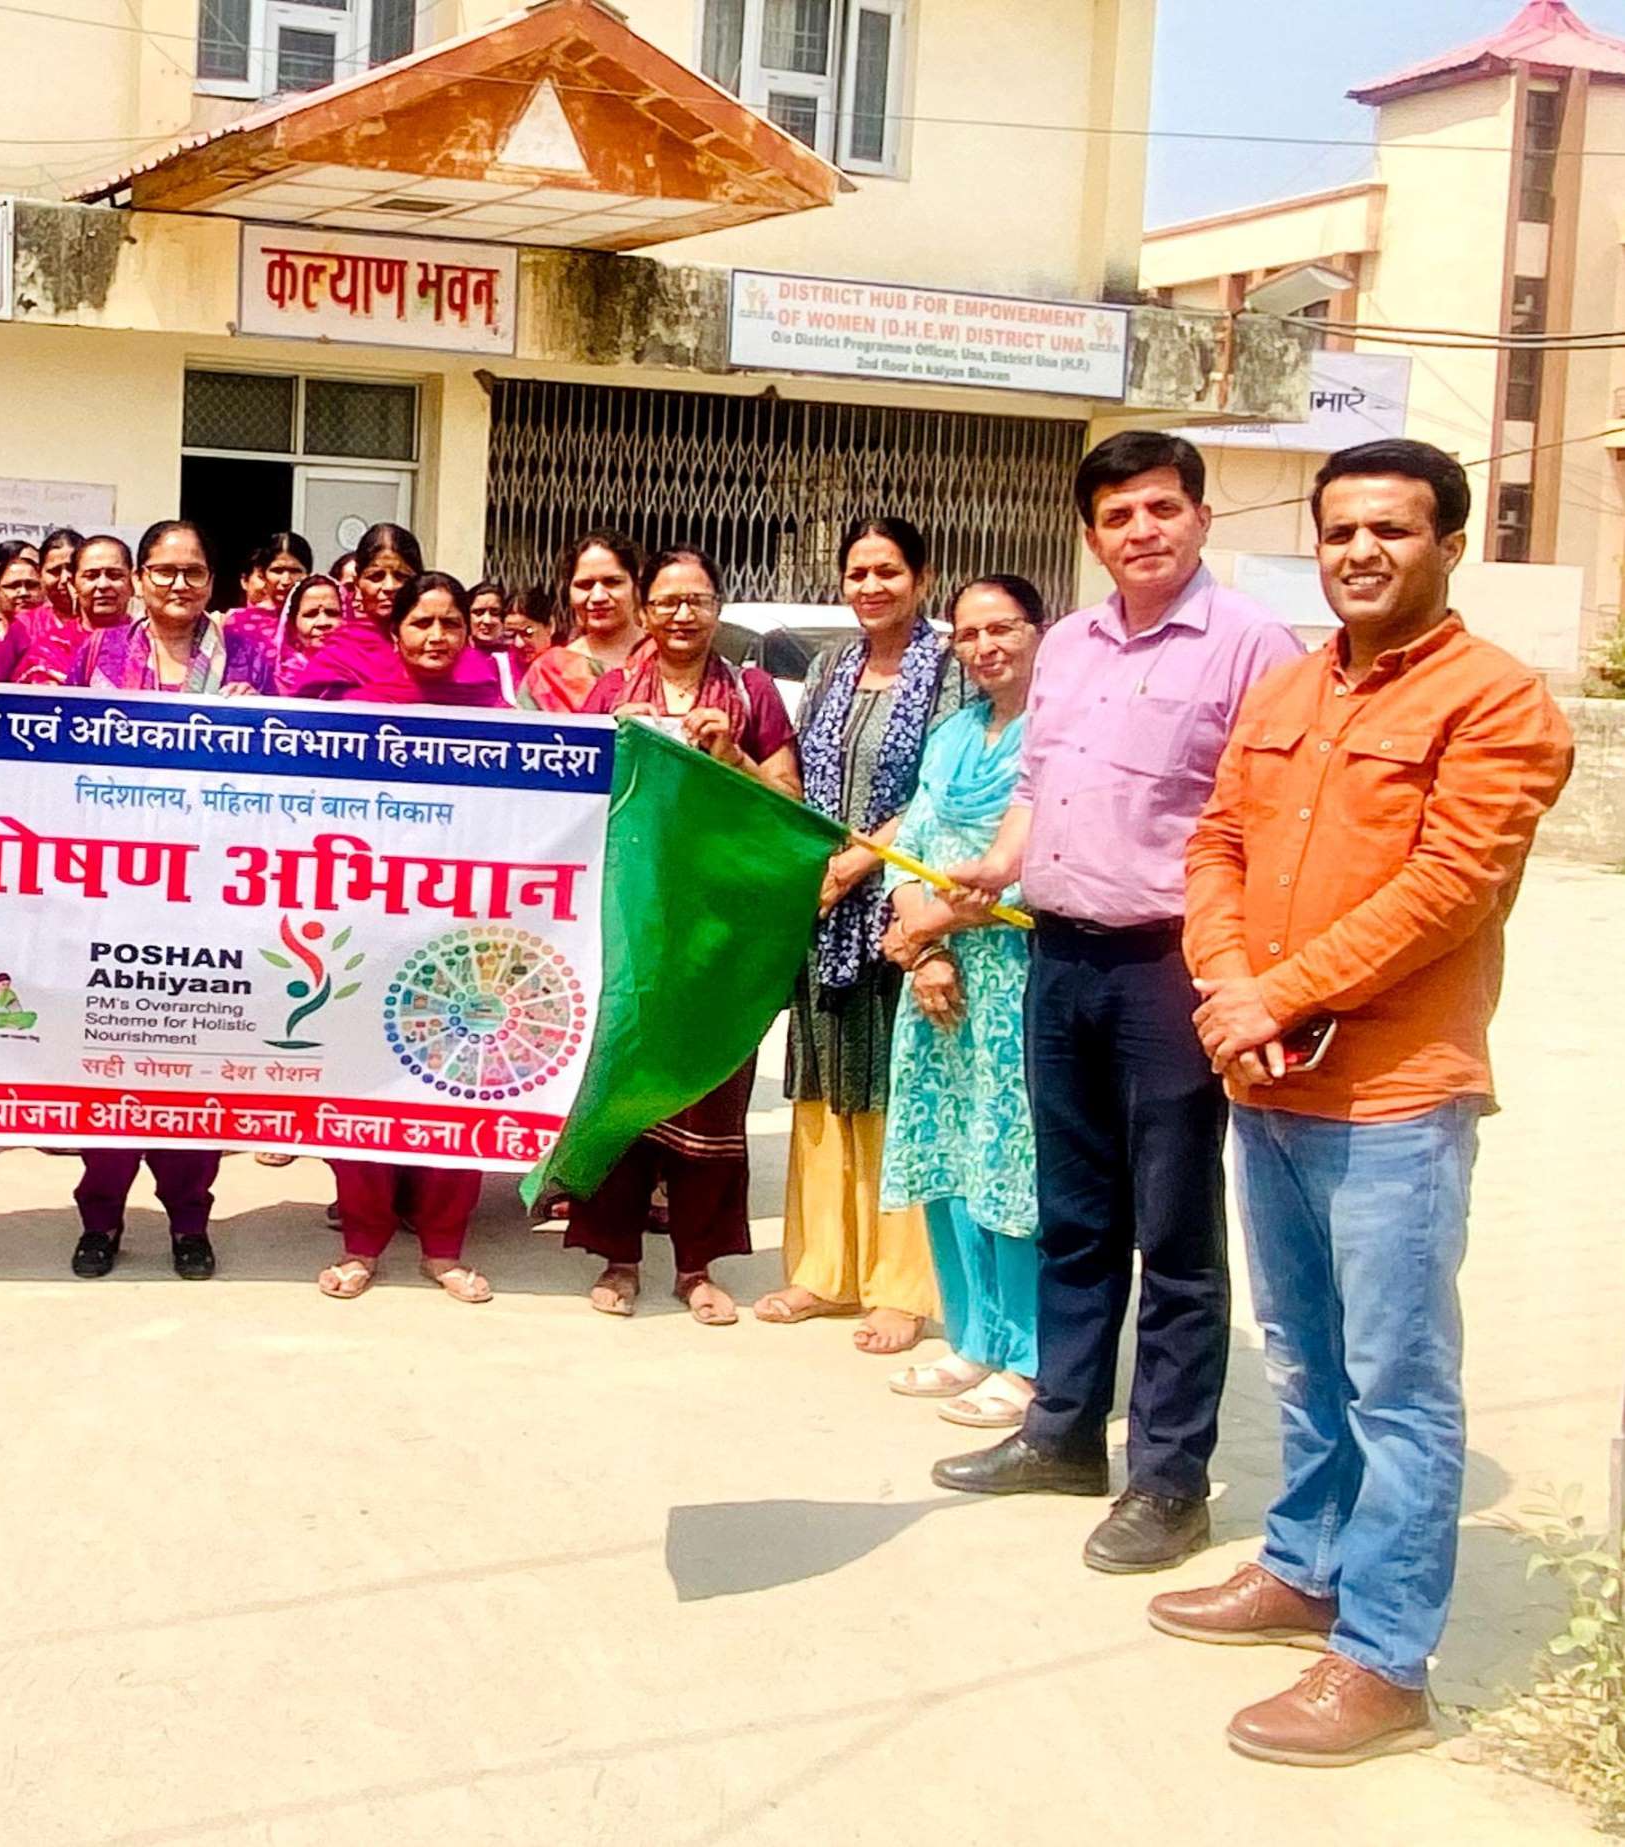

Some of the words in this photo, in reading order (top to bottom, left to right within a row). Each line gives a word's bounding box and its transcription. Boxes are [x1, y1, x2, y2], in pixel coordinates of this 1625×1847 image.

[260, 247, 408, 320] कल्याण
[417, 261, 500, 325] भवन
[778, 281, 864, 306] DISTRICT
[870, 288, 907, 311] HUB
[913, 292, 948, 315] FOR
[954, 296, 1086, 328] EMPOWERMENT
[777, 309, 802, 327] OF
[807, 311, 875, 335] WOMEN
[966, 326, 1044, 351] DISTRICT
[1050, 335, 1086, 353] UNA
[795, 332, 841, 348] District
[10, 705, 62, 752] एवं
[69, 710, 254, 757] अधिकारिता
[262, 718, 368, 763] विभाग
[374, 724, 509, 769] हिमाचल
[520, 733, 600, 777] प्रदेश
[75, 775, 192, 815] निदेशालय,
[201, 783, 271, 816] महिला
[279, 789, 315, 823] एवं
[321, 797, 368, 822] बाल
[374, 791, 454, 826] विकास
[222, 833, 587, 922] अभियान
[91, 942, 243, 969] POSHAN
[86, 968, 252, 996] Abhiyaan
[85, 1013, 158, 1028] Scheme
[164, 1015, 186, 1029] for
[193, 1018, 257, 1033] Holistic
[86, 996, 129, 1011] PM's
[136, 999, 244, 1017] Overarching
[84, 1028, 197, 1046] Nourishment
[82, 1055, 124, 1077] सही
[134, 1056, 192, 1079] पोषण
[221, 1060, 256, 1082] देश
[266, 1060, 322, 1083] रोशन
[88, 1094, 226, 1137] अधिकारी
[232, 1105, 303, 1145] ऊना,
[316, 1104, 393, 1144] जिला
[401, 1115, 465, 1151] ऊना
